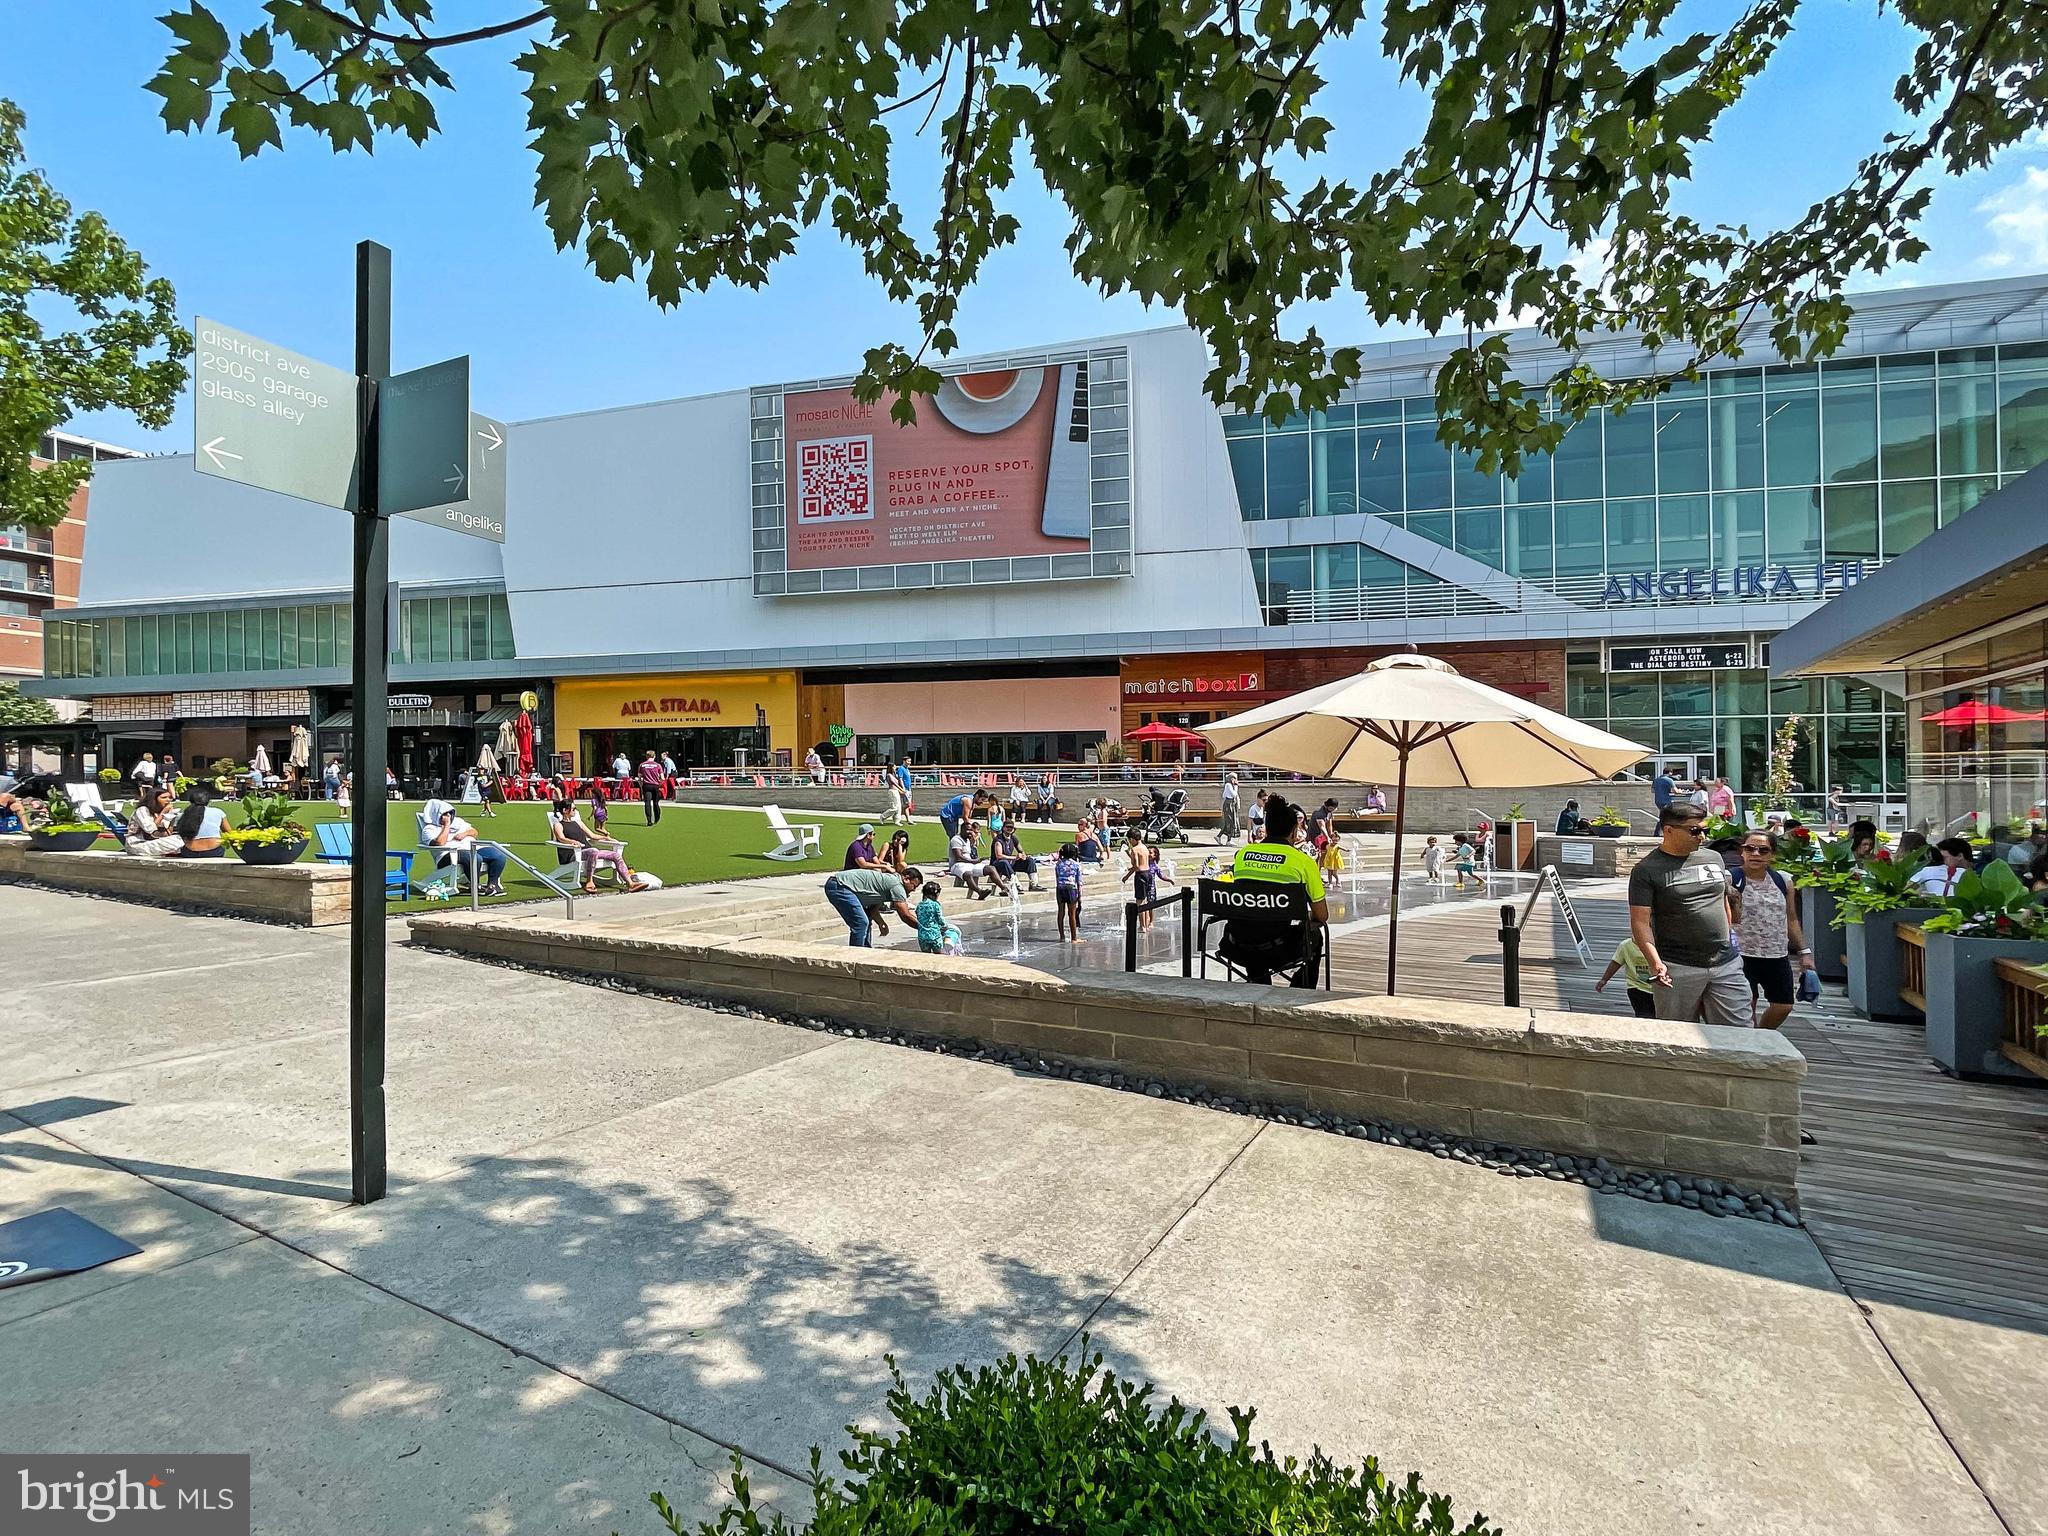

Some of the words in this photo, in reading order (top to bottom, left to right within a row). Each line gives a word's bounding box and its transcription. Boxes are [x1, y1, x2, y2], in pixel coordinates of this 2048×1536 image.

[202, 329, 271, 366] district
[277, 357, 311, 379] ave
[202, 351, 256, 383] 2905
[262, 376, 329, 408] garage
[202, 380, 257, 408] glass
[263, 399, 305, 425] alley
[796, 409, 840, 422] mosaic
[841, 404, 873, 420] NICHE
[889, 466, 947, 480] RESERVE
[952, 463, 989, 476] YOUR
[995, 459, 1034, 472] SPOT,
[889, 482, 922, 493] PLUG
[927, 481, 941, 491] IN
[946, 478, 974, 489] AND
[889, 495, 924, 506] GRAB
[930, 494, 938, 504] A
[944, 489, 1009, 502] COFFEE...
[889, 509, 910, 518] MEET
[912, 508, 929, 517] AND
[932, 506, 957, 515] WORK
[960, 505, 970, 513] AT
[973, 503, 1001, 512] NICHE.
[446, 509, 503, 534] angelika
[889, 525, 922, 534] LOCATED
[924, 524, 935, 532] ON
[936, 522, 969, 531] DISTRICT
[971, 520, 986, 528] AVE
[798, 532, 816, 540] SCAN
[829, 528, 870, 537] DOWNLOAD
[844, 534, 875, 543] RESERVE
[889, 532, 908, 541] NEXT
[909, 531, 919, 539] TO
[921, 530, 941, 539] WEST
[943, 529, 958, 537] ELM
[921, 536, 957, 545] ANGELIKA
[959, 533, 995, 543] THEATER)
[819, 543, 836, 551] SPOT
[849, 541, 870, 549] NICHE
[1603, 566, 1799, 600] ANGELIKA
[1649, 654, 1686, 662] ASTEROID
[1124, 677, 1237, 694] matchbox
[388, 696, 428, 707] BULLETIN
[621, 699, 658, 717] ALTA
[659, 697, 720, 714] STRADA
[829, 724, 854, 738] Kirby
[830, 733, 850, 746] Club
[1245, 852, 1284, 863] mosaic
[1244, 861, 1280, 871] SECURITY
[1212, 888, 1290, 908] mosaic
